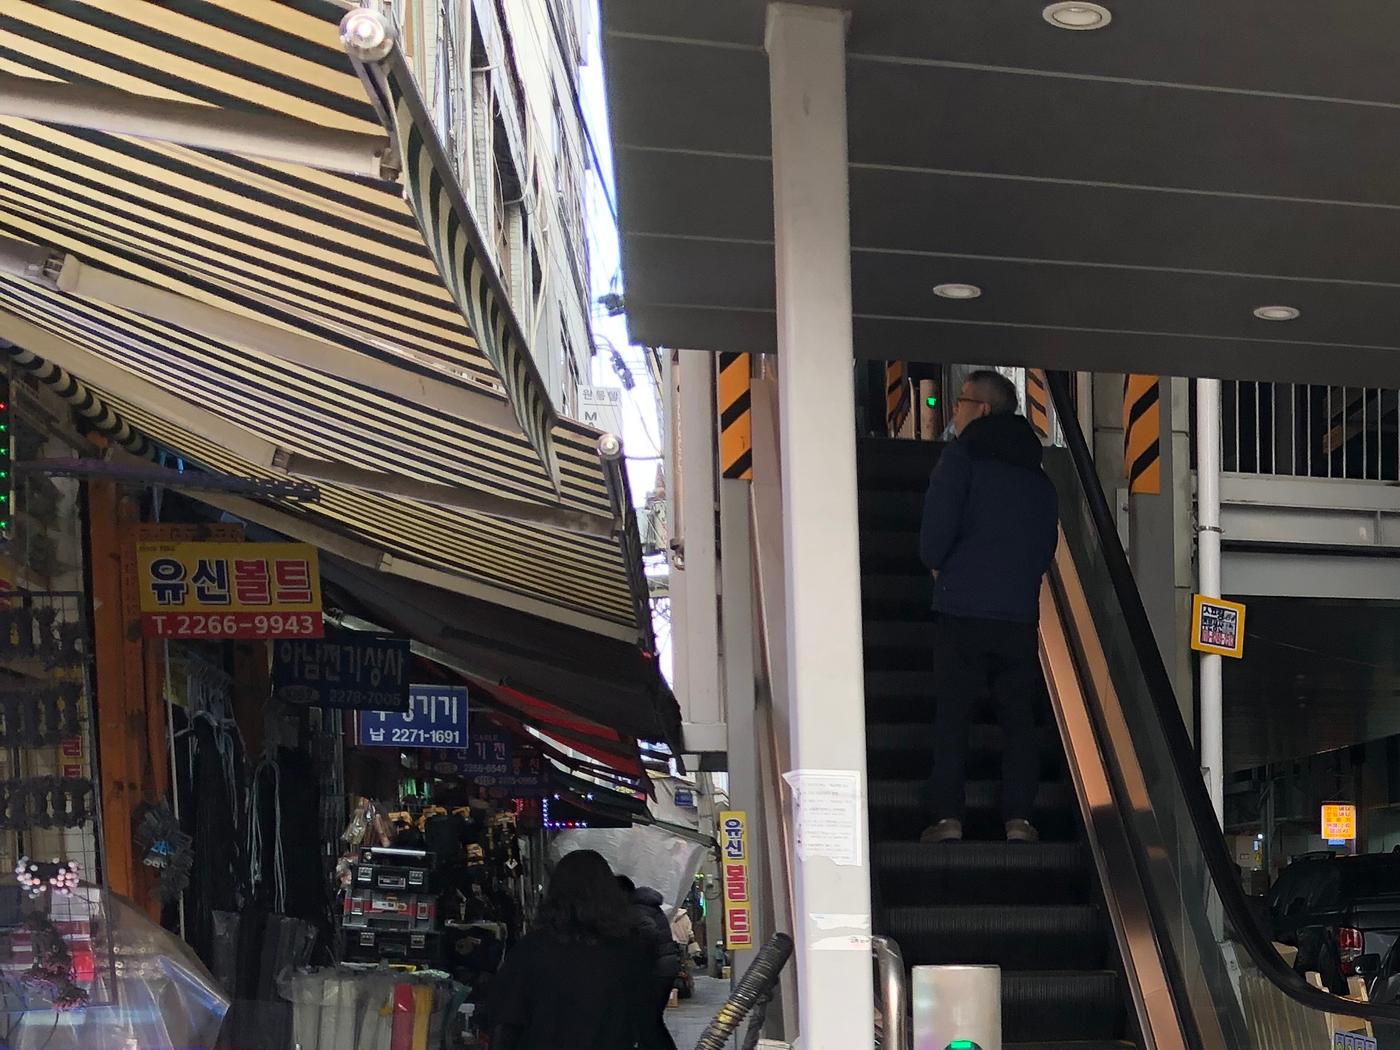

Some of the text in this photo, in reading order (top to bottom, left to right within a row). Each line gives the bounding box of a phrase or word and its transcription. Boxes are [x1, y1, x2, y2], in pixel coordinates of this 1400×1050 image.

[150, 558, 313, 605] 유신볼트
[152, 616, 314, 635] T.2266-9943
[371, 696, 458, 725] 기기
[392, 729, 460, 743] 2271-1691
[724, 818, 751, 945] 유신볼트
